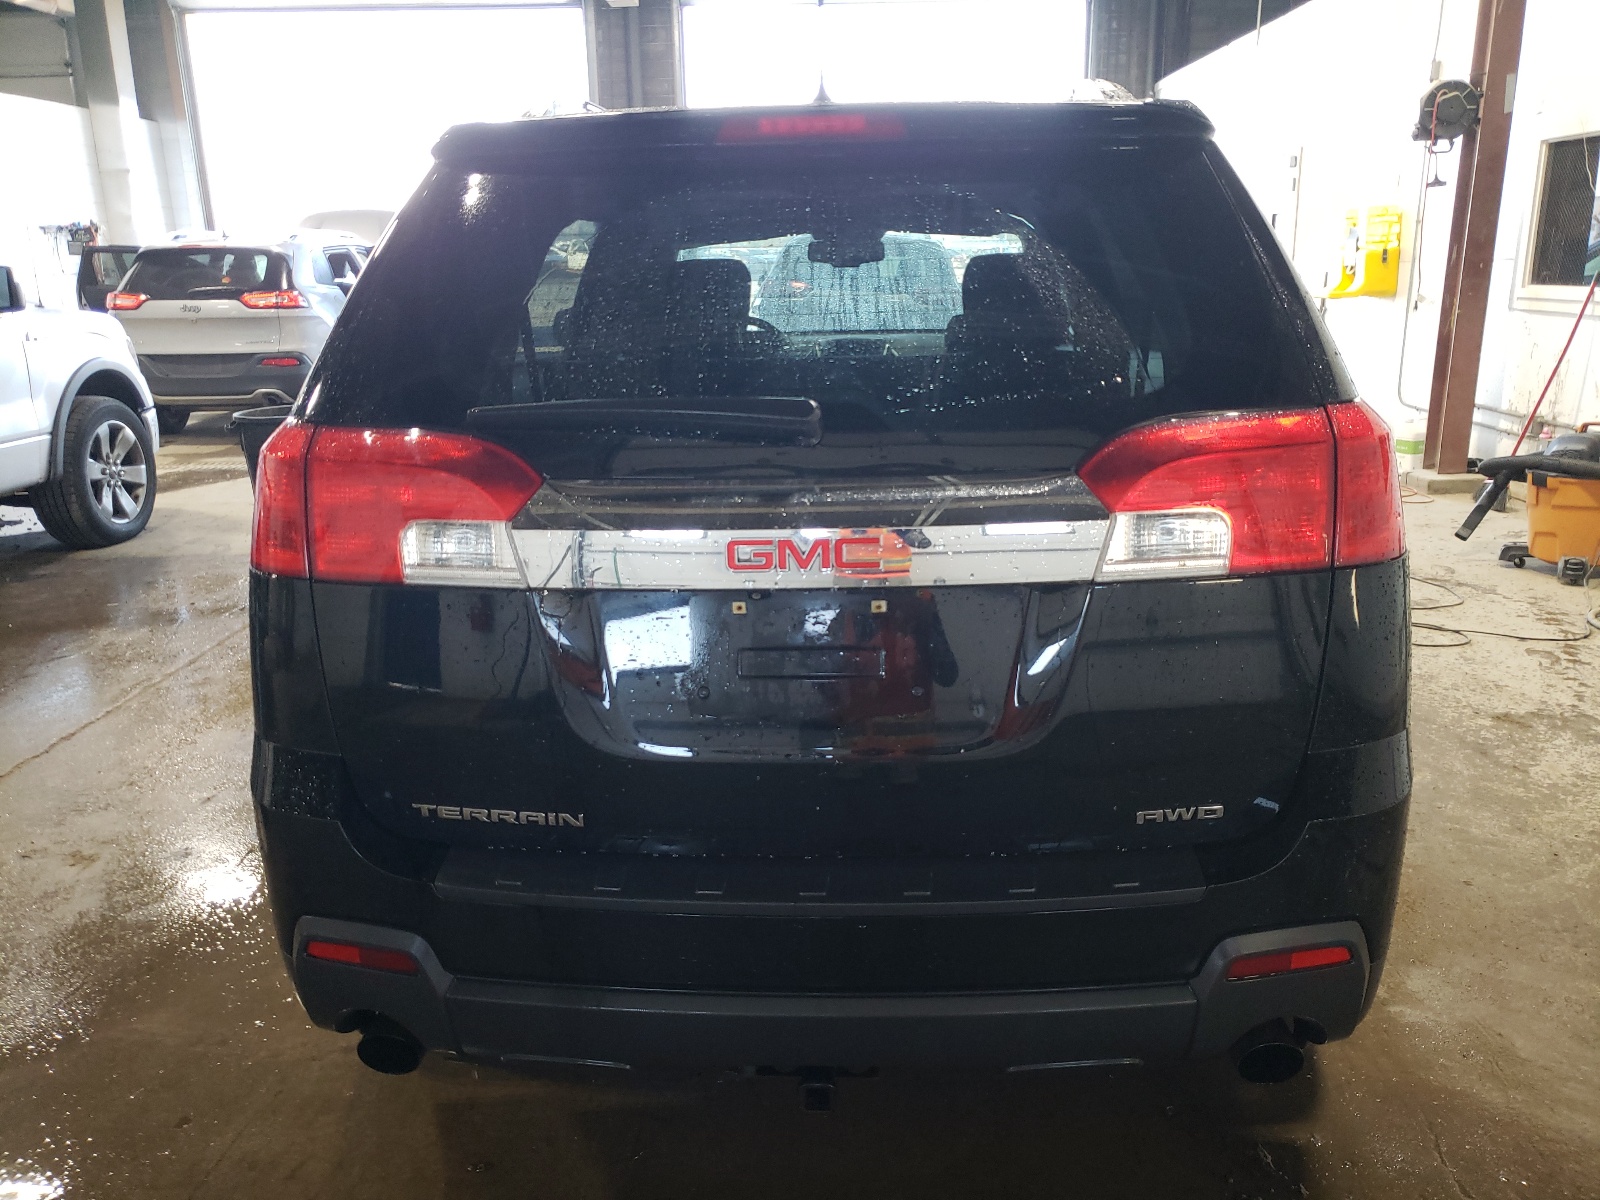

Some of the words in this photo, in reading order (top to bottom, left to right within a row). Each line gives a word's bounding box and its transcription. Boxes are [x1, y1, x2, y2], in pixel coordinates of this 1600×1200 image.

[726, 538, 883, 571] GMC
[411, 802, 585, 828] TERRAIN
[1135, 805, 1225, 825] AWD
